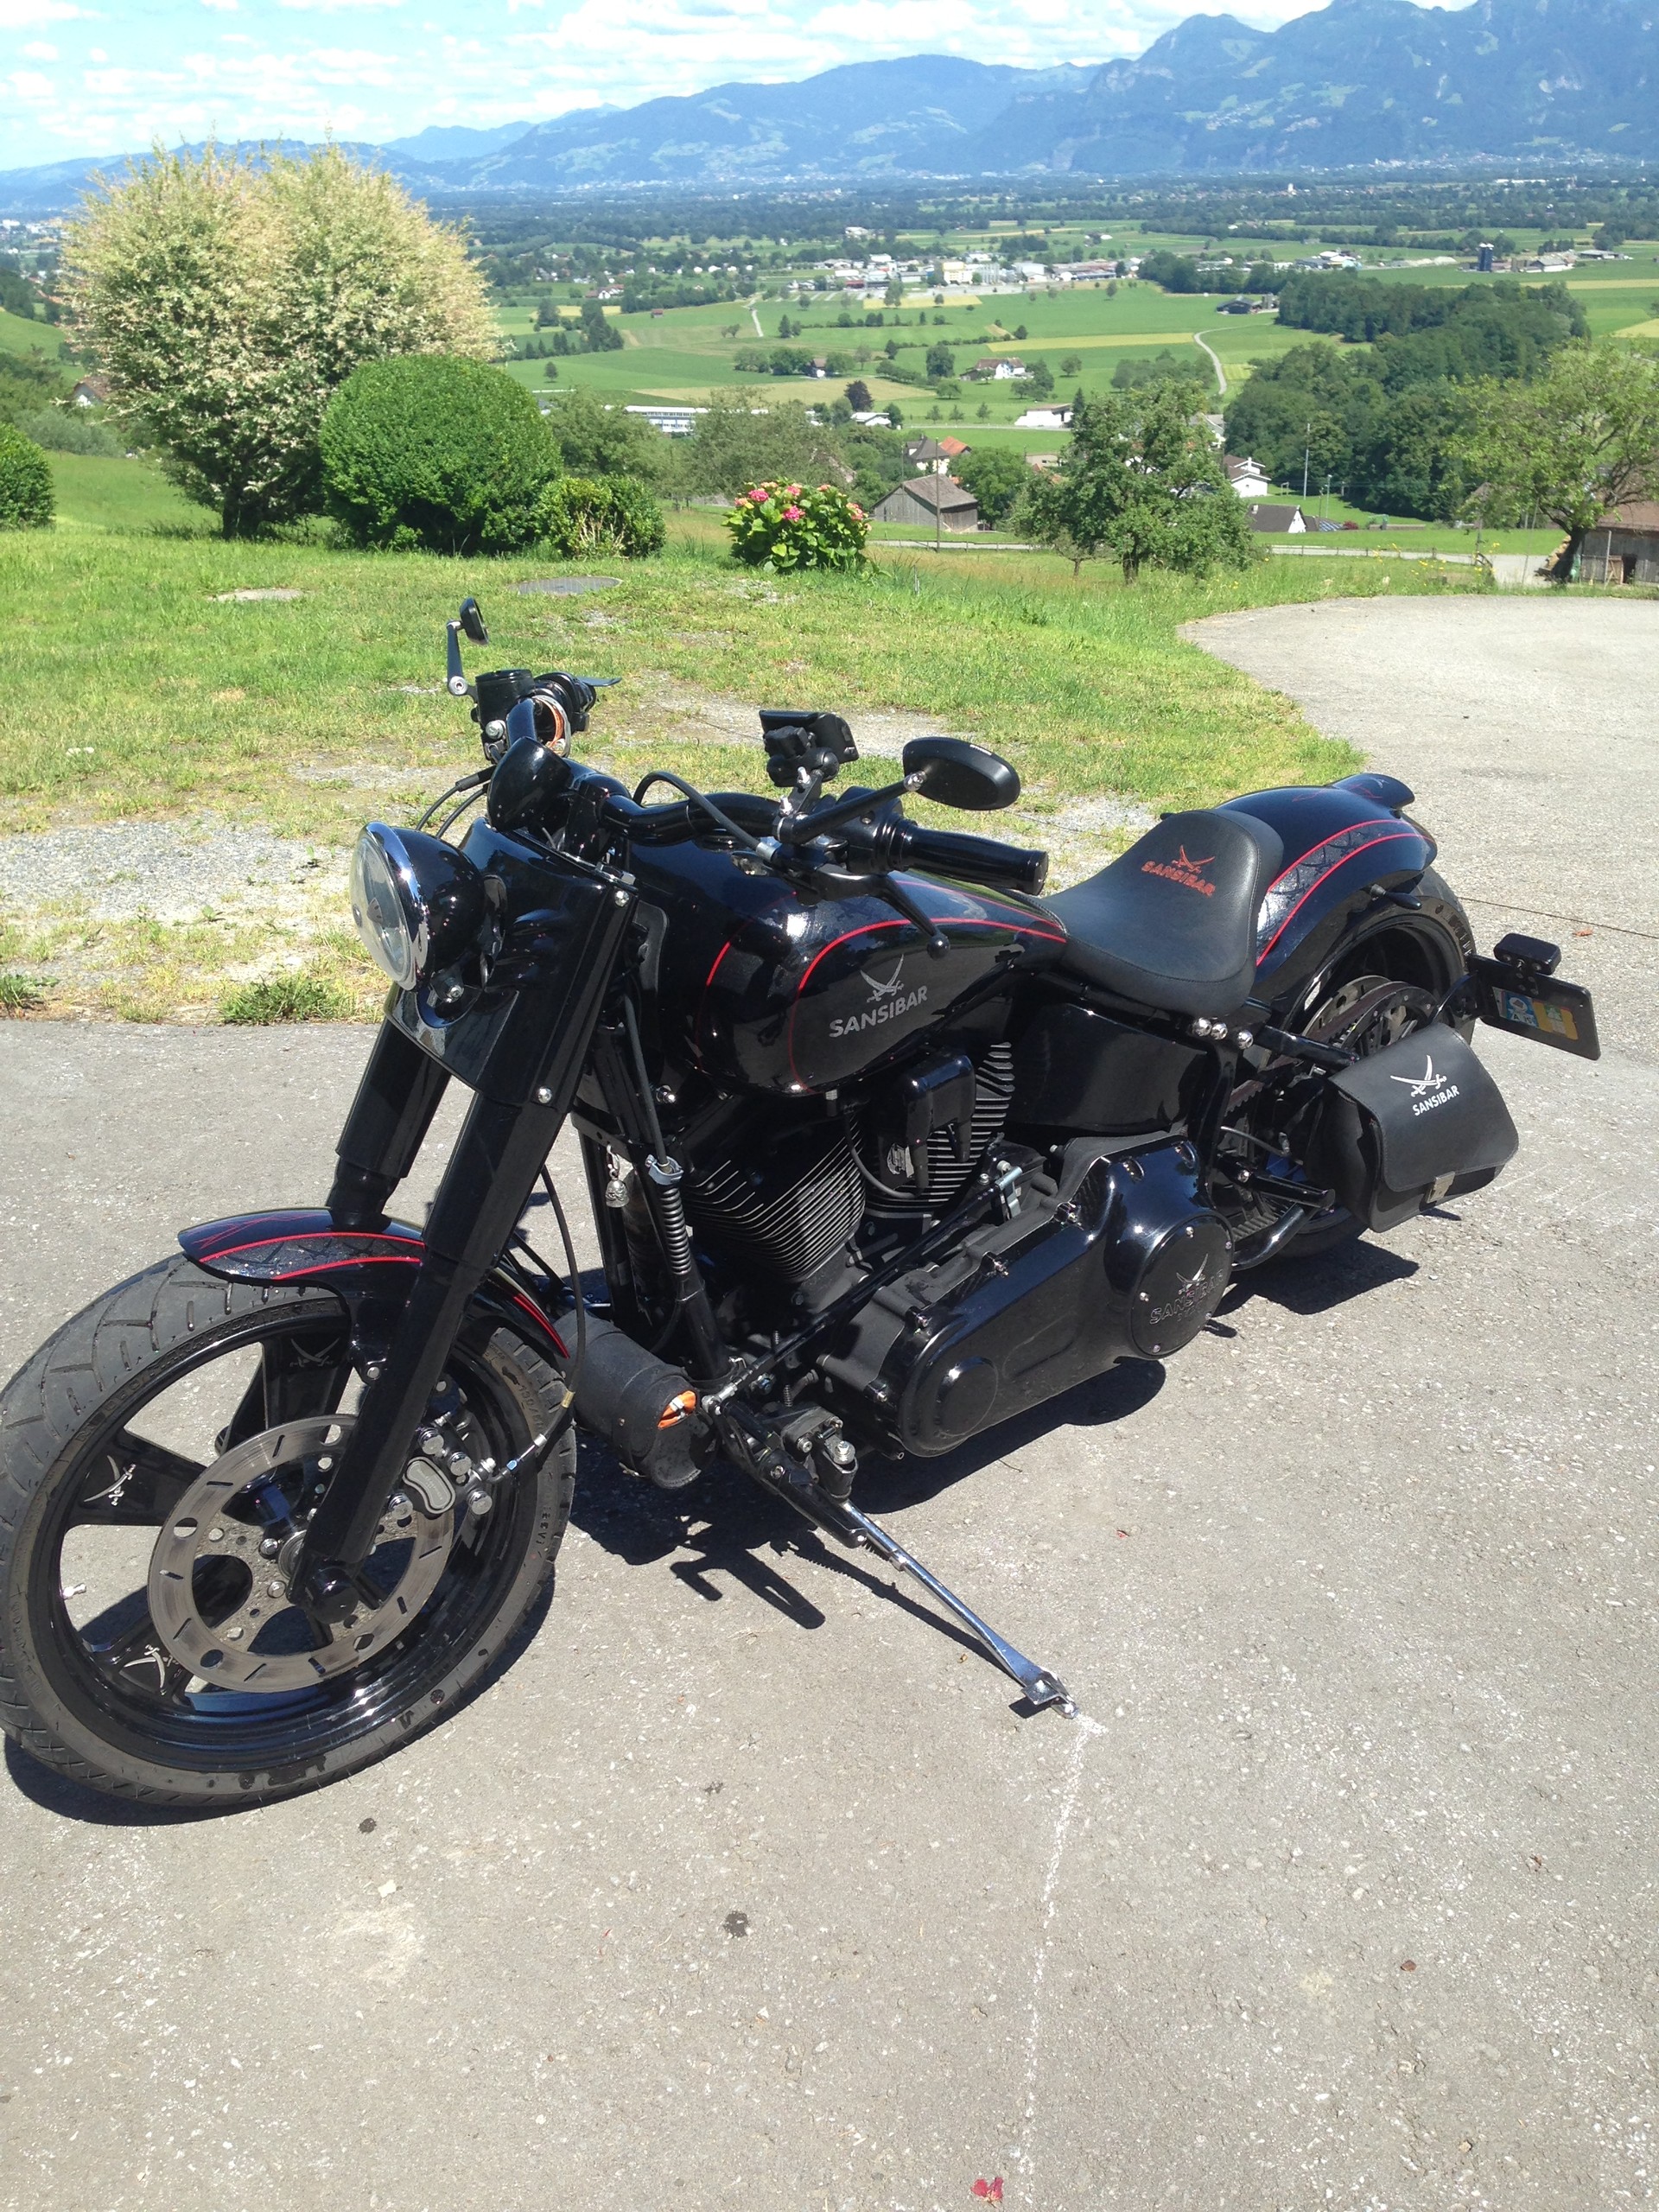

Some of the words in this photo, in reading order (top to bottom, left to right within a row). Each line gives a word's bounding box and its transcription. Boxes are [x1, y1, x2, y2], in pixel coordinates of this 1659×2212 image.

[1141, 861, 1216, 896] SANSIBAR
[829, 985, 928, 1038] SANSIBAR
[1412, 1084, 1460, 1116] SANSIBAR
